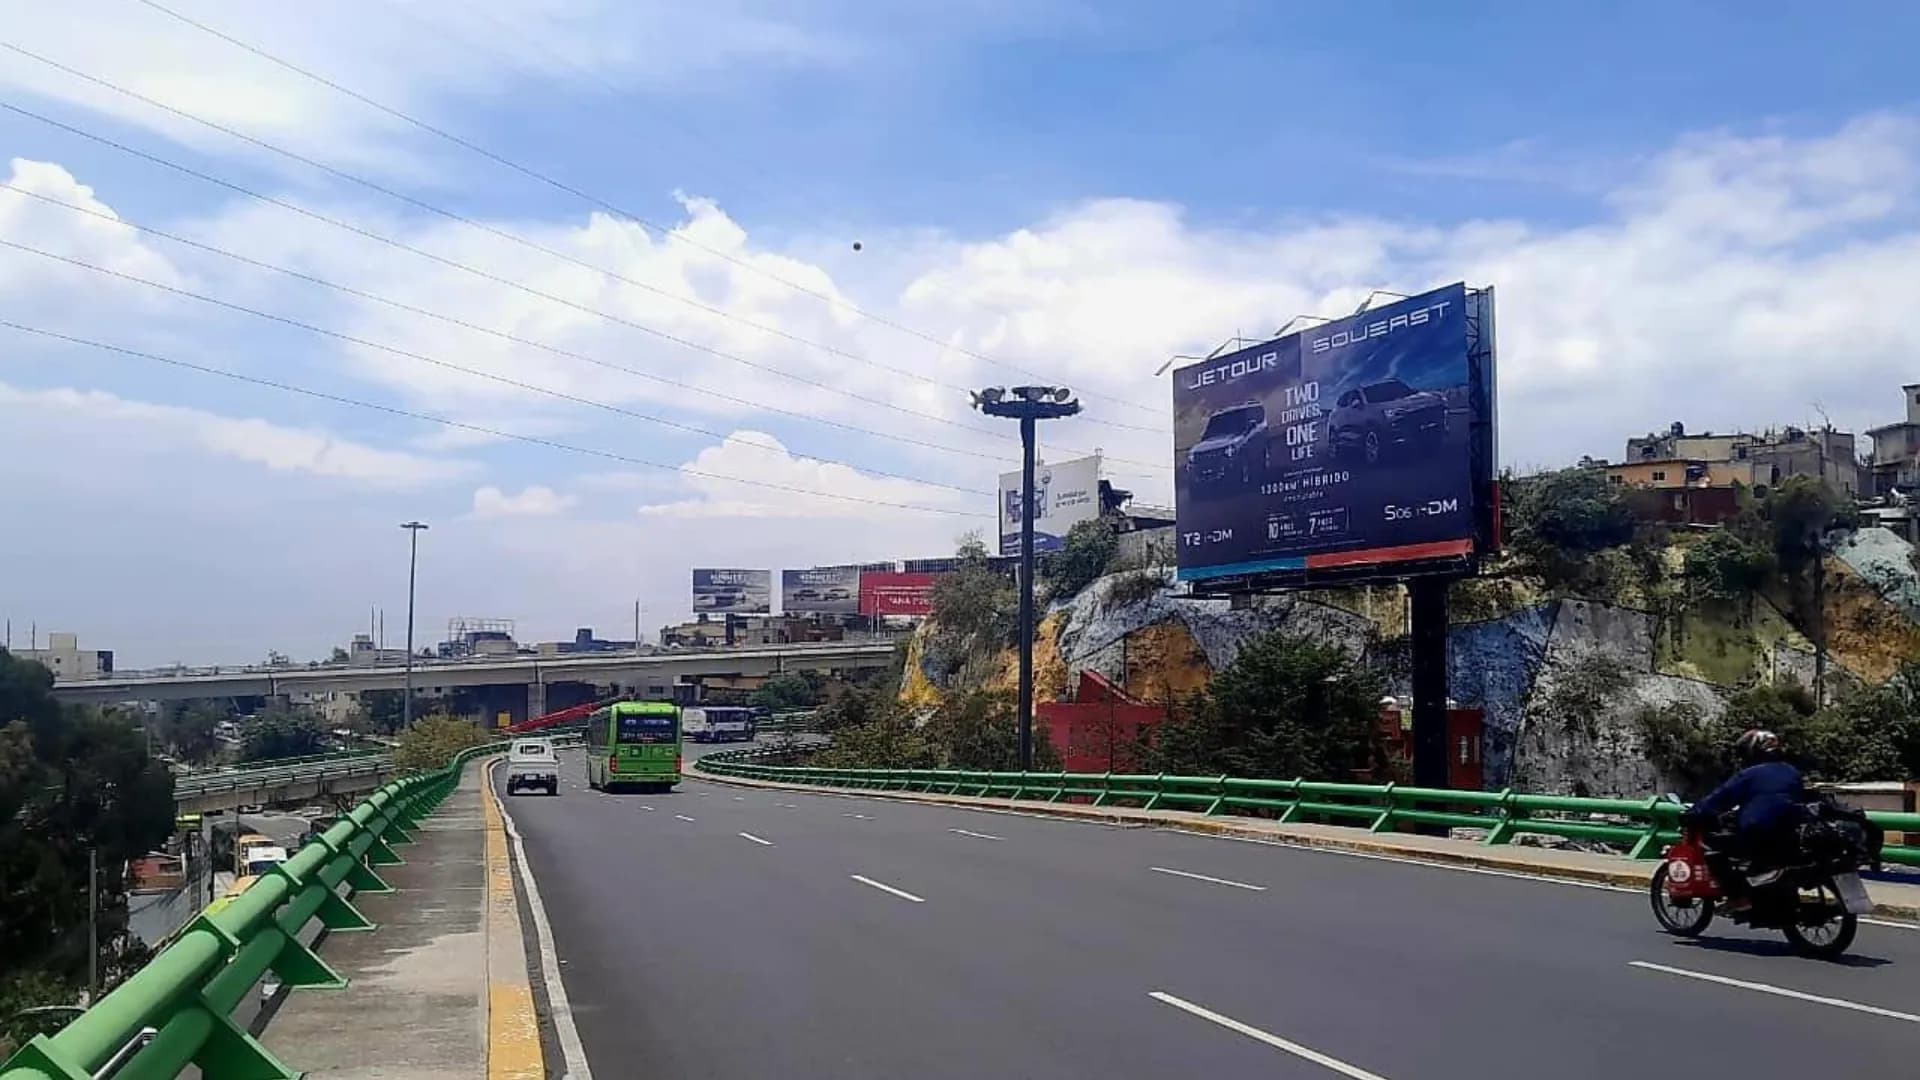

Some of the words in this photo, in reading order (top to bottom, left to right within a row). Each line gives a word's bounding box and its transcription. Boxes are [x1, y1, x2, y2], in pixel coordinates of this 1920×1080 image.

[1312, 301, 1451, 353] SOUEAST
[1188, 351, 1278, 390] JETOUR
[1285, 381, 1319, 407] TWO
[1286, 421, 1319, 446] ONE
[1291, 444, 1314, 460] LIFE
[1183, 531, 1201, 546] T2
